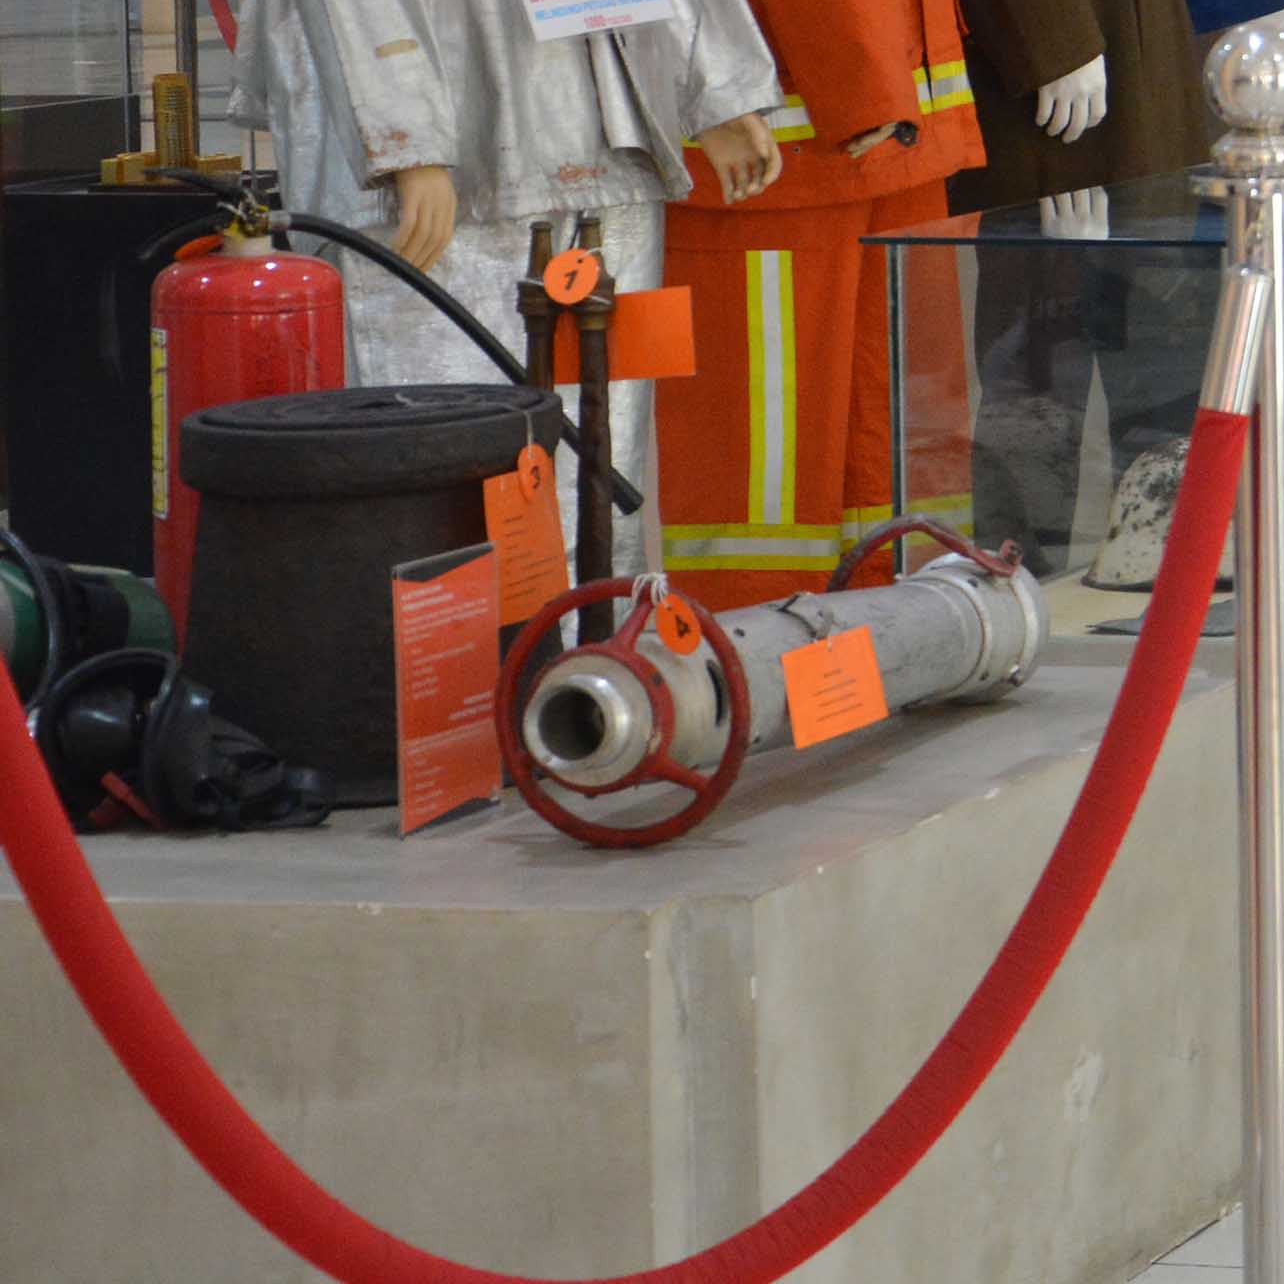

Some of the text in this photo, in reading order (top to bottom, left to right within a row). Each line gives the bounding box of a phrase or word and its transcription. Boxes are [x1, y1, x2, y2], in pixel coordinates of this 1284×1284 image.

[565, 269, 579, 291] 1
[530, 464, 541, 490] 3
[674, 614, 691, 639] 4
